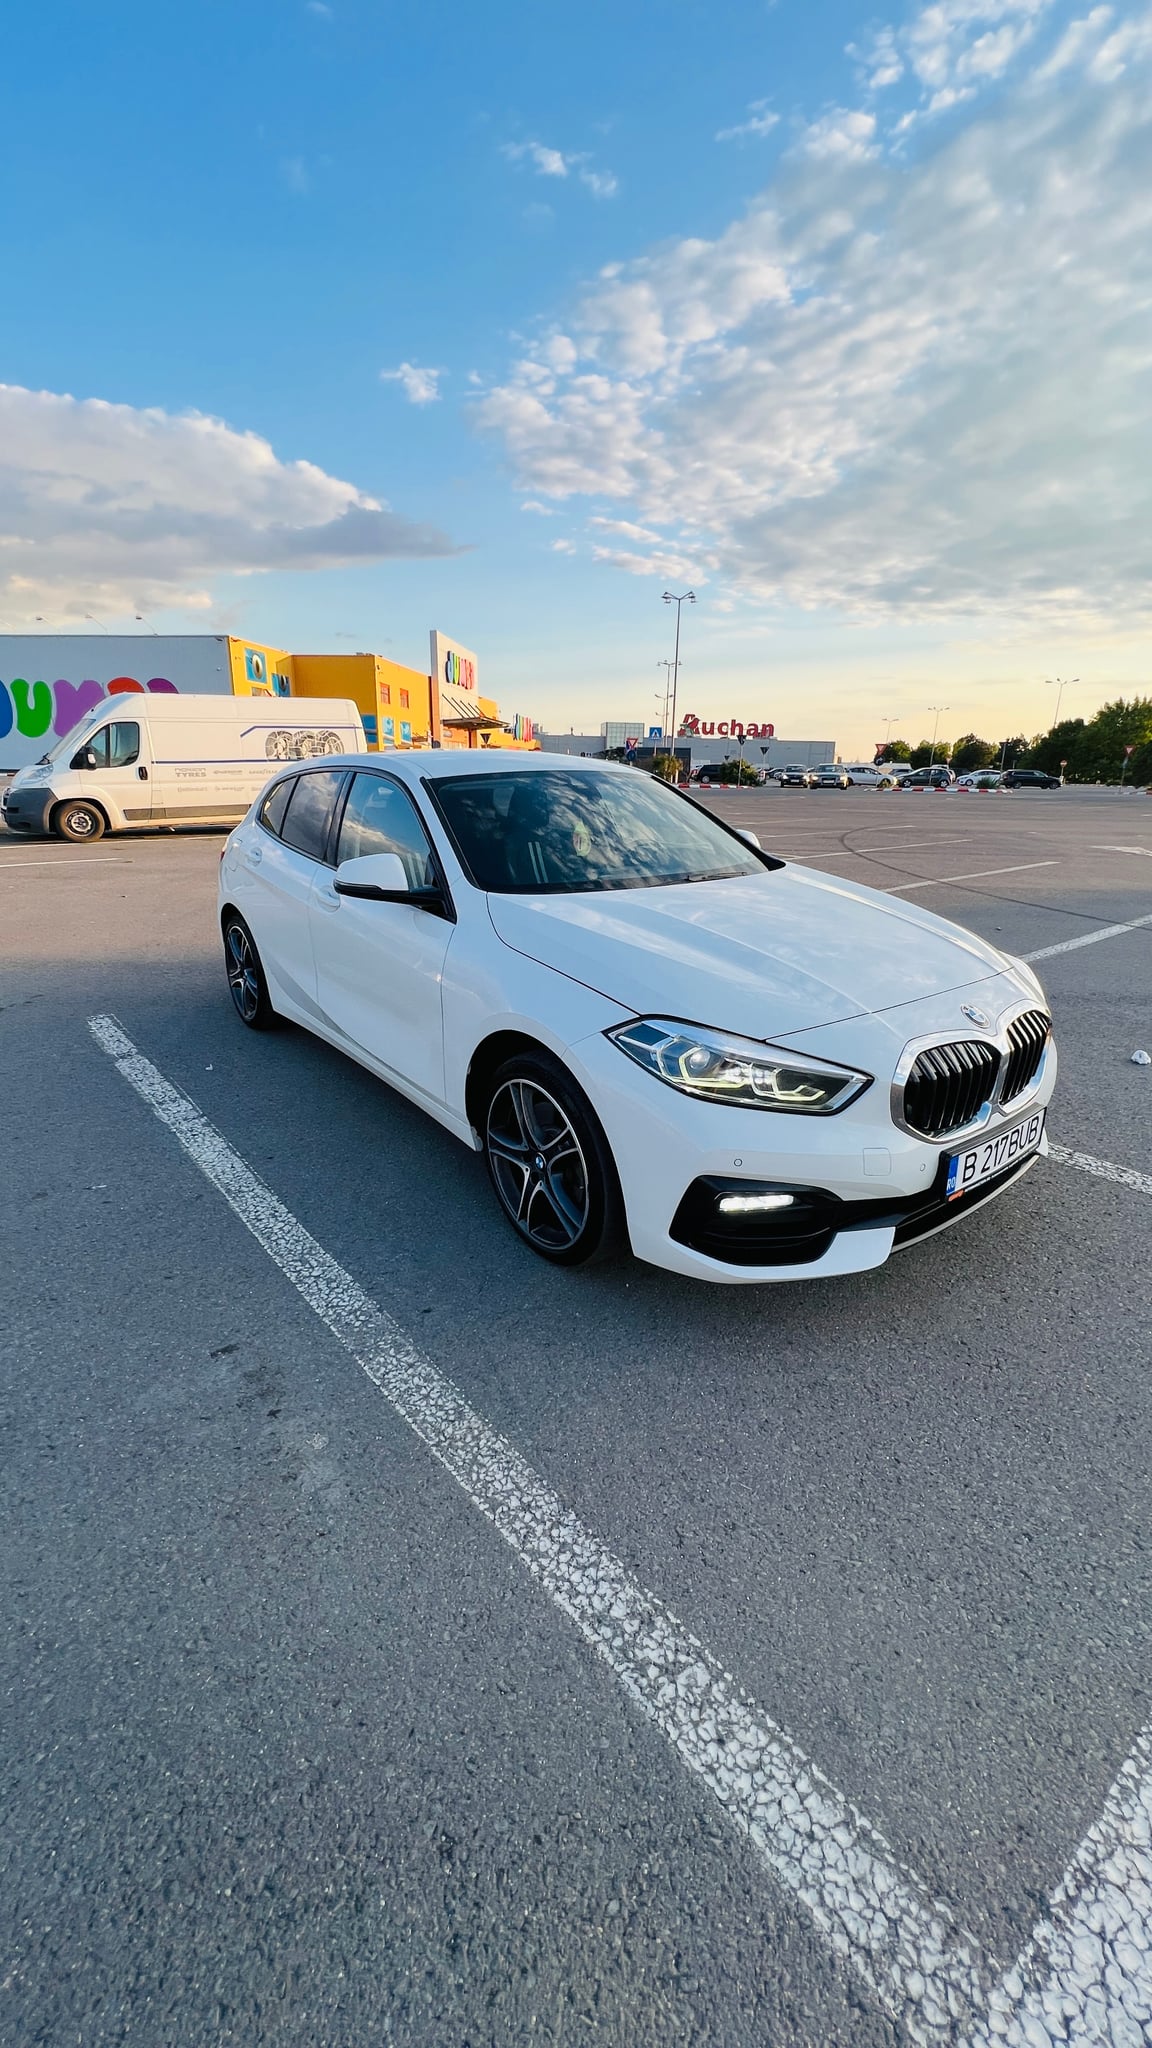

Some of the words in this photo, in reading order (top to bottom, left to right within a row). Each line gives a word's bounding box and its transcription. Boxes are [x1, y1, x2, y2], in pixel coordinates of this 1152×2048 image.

[677, 714, 775, 738] Auchan
[962, 1152, 977, 1184] B
[946, 1177, 956, 1192] RO
